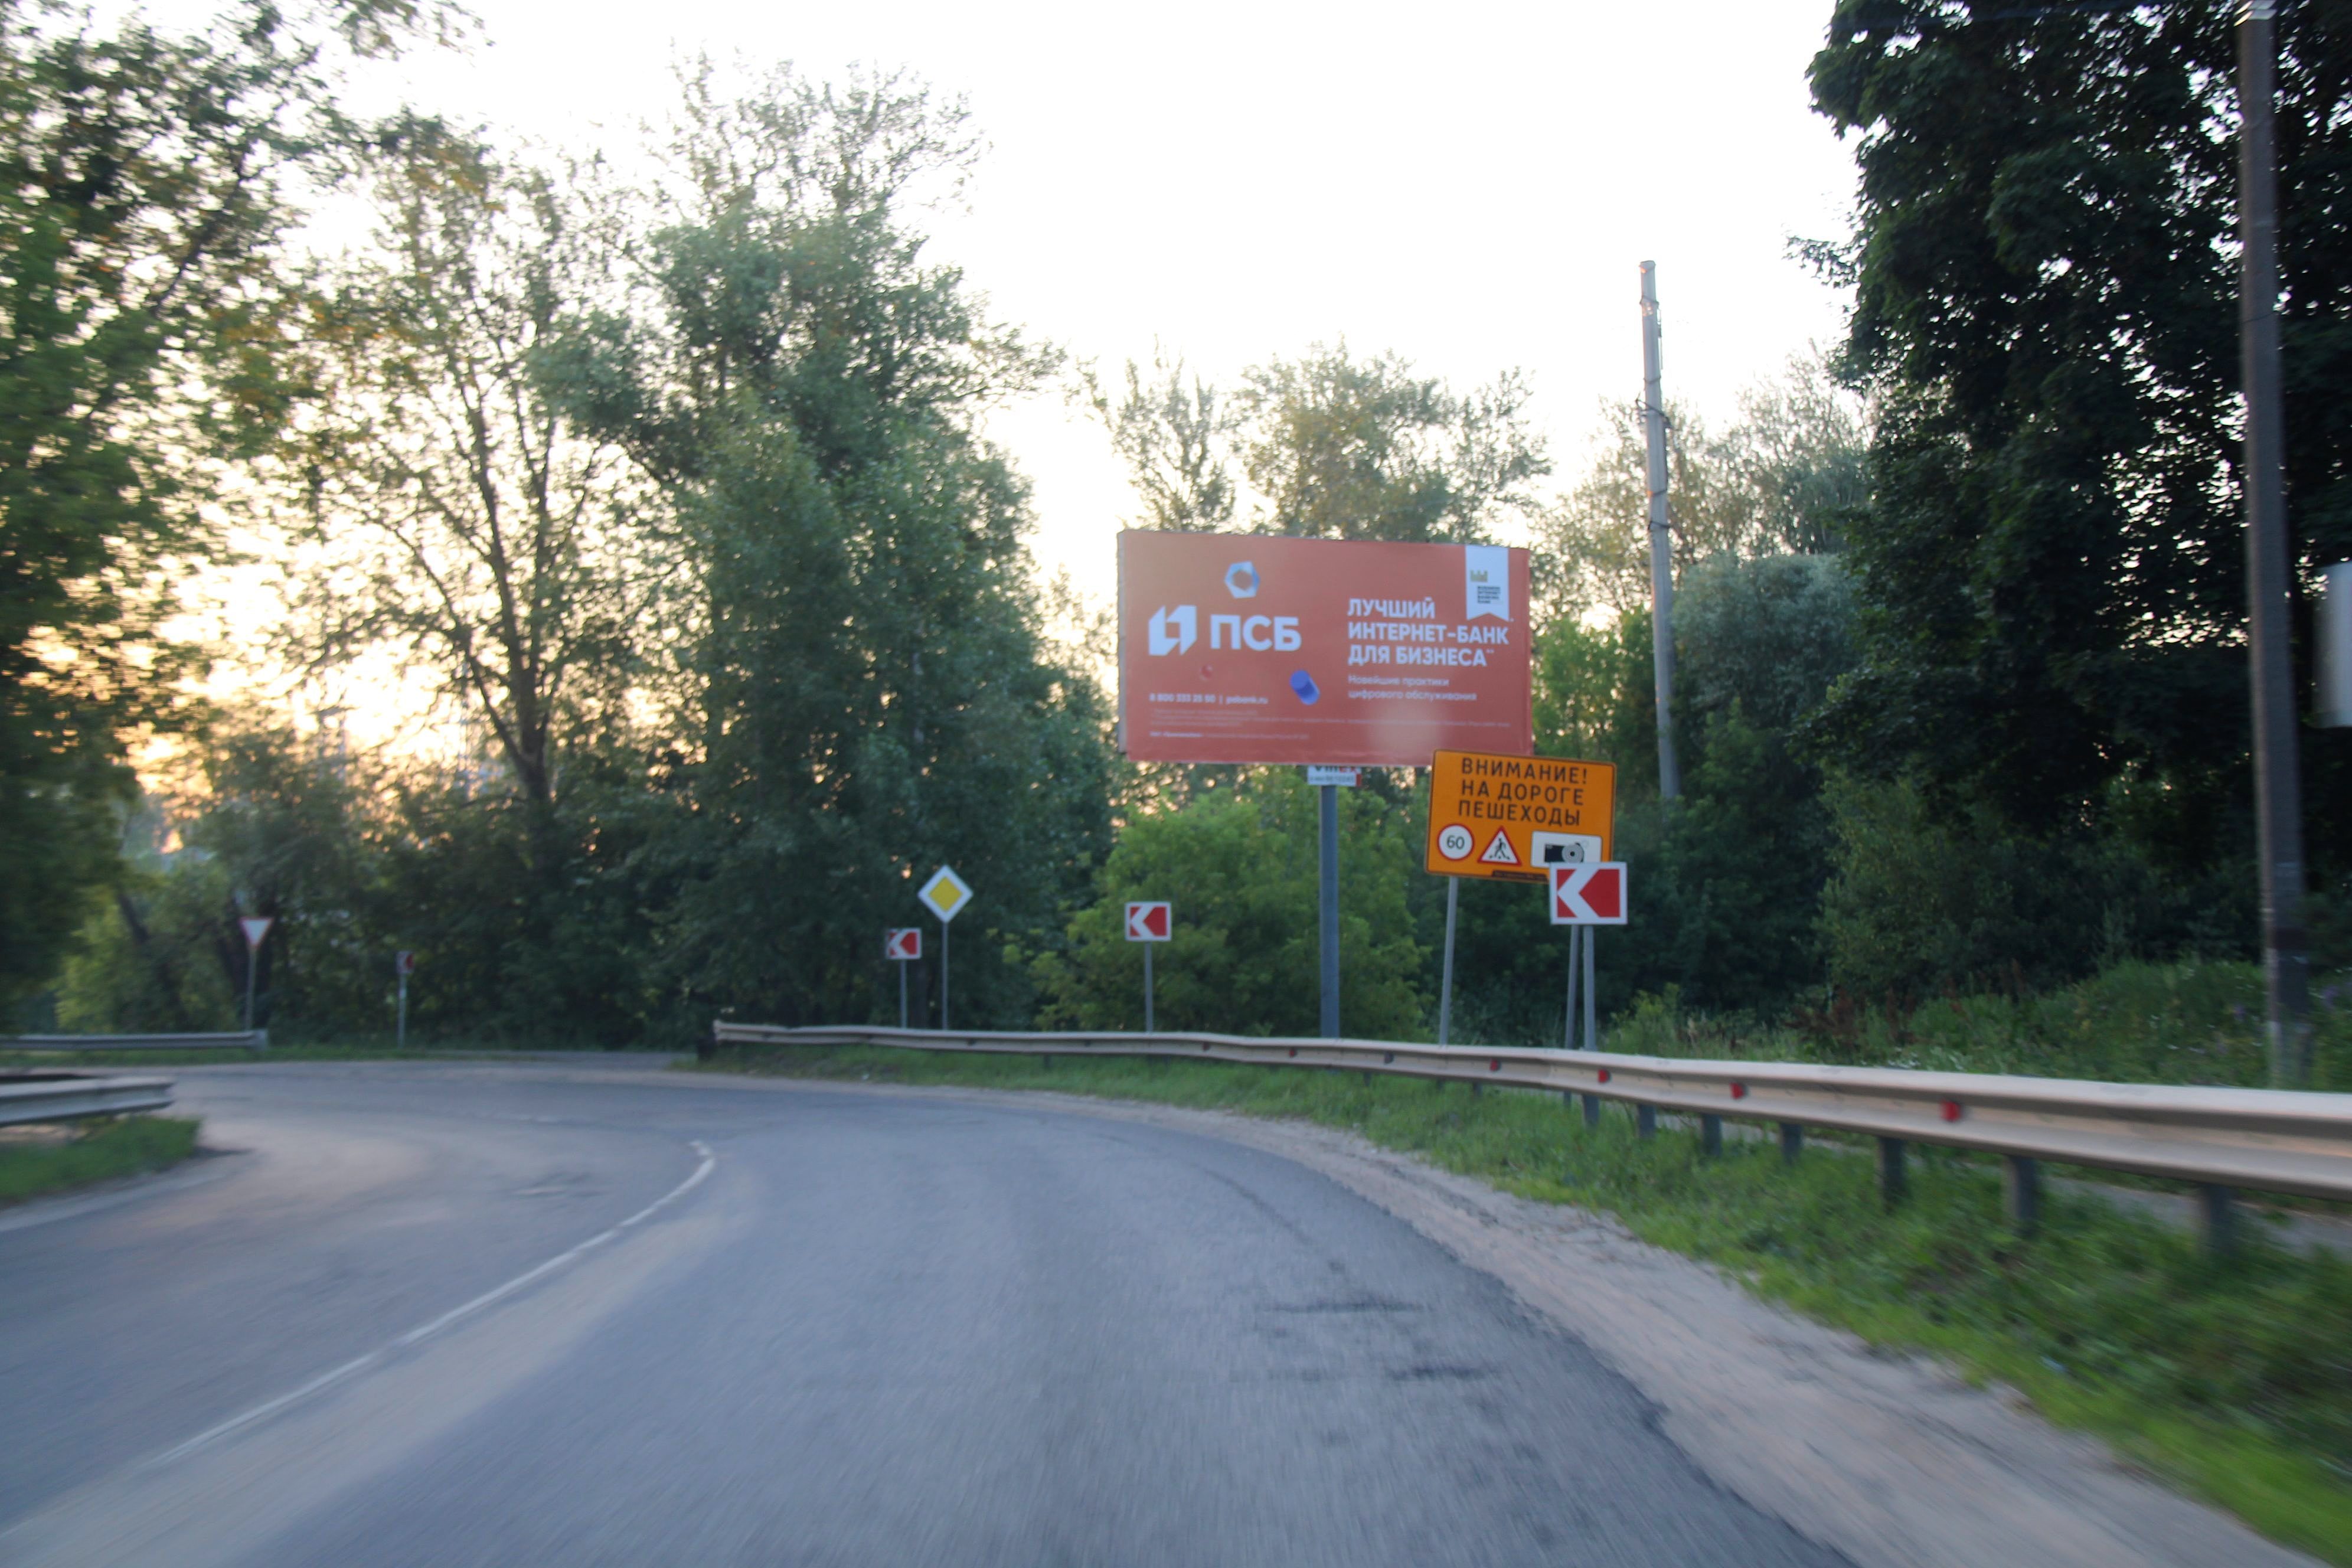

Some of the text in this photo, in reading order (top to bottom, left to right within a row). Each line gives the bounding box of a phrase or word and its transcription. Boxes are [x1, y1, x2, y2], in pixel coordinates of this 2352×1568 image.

[1347, 597, 1435, 619] ЛУЧШИЙ
[1210, 614, 1302, 652] ПСБ
[1348, 622, 1509, 645] ИНТЕРНЕТ-БАНК
[1348, 644, 1390, 667] ДЛЯ
[1461, 757, 1588, 785] ВНИМАНИЕ!
[1461, 780, 1585, 806] НА ДОРОГЕ
[1458, 800, 1580, 827] ПЕШЕХОДЫ
[1446, 835, 1465, 850] 60
